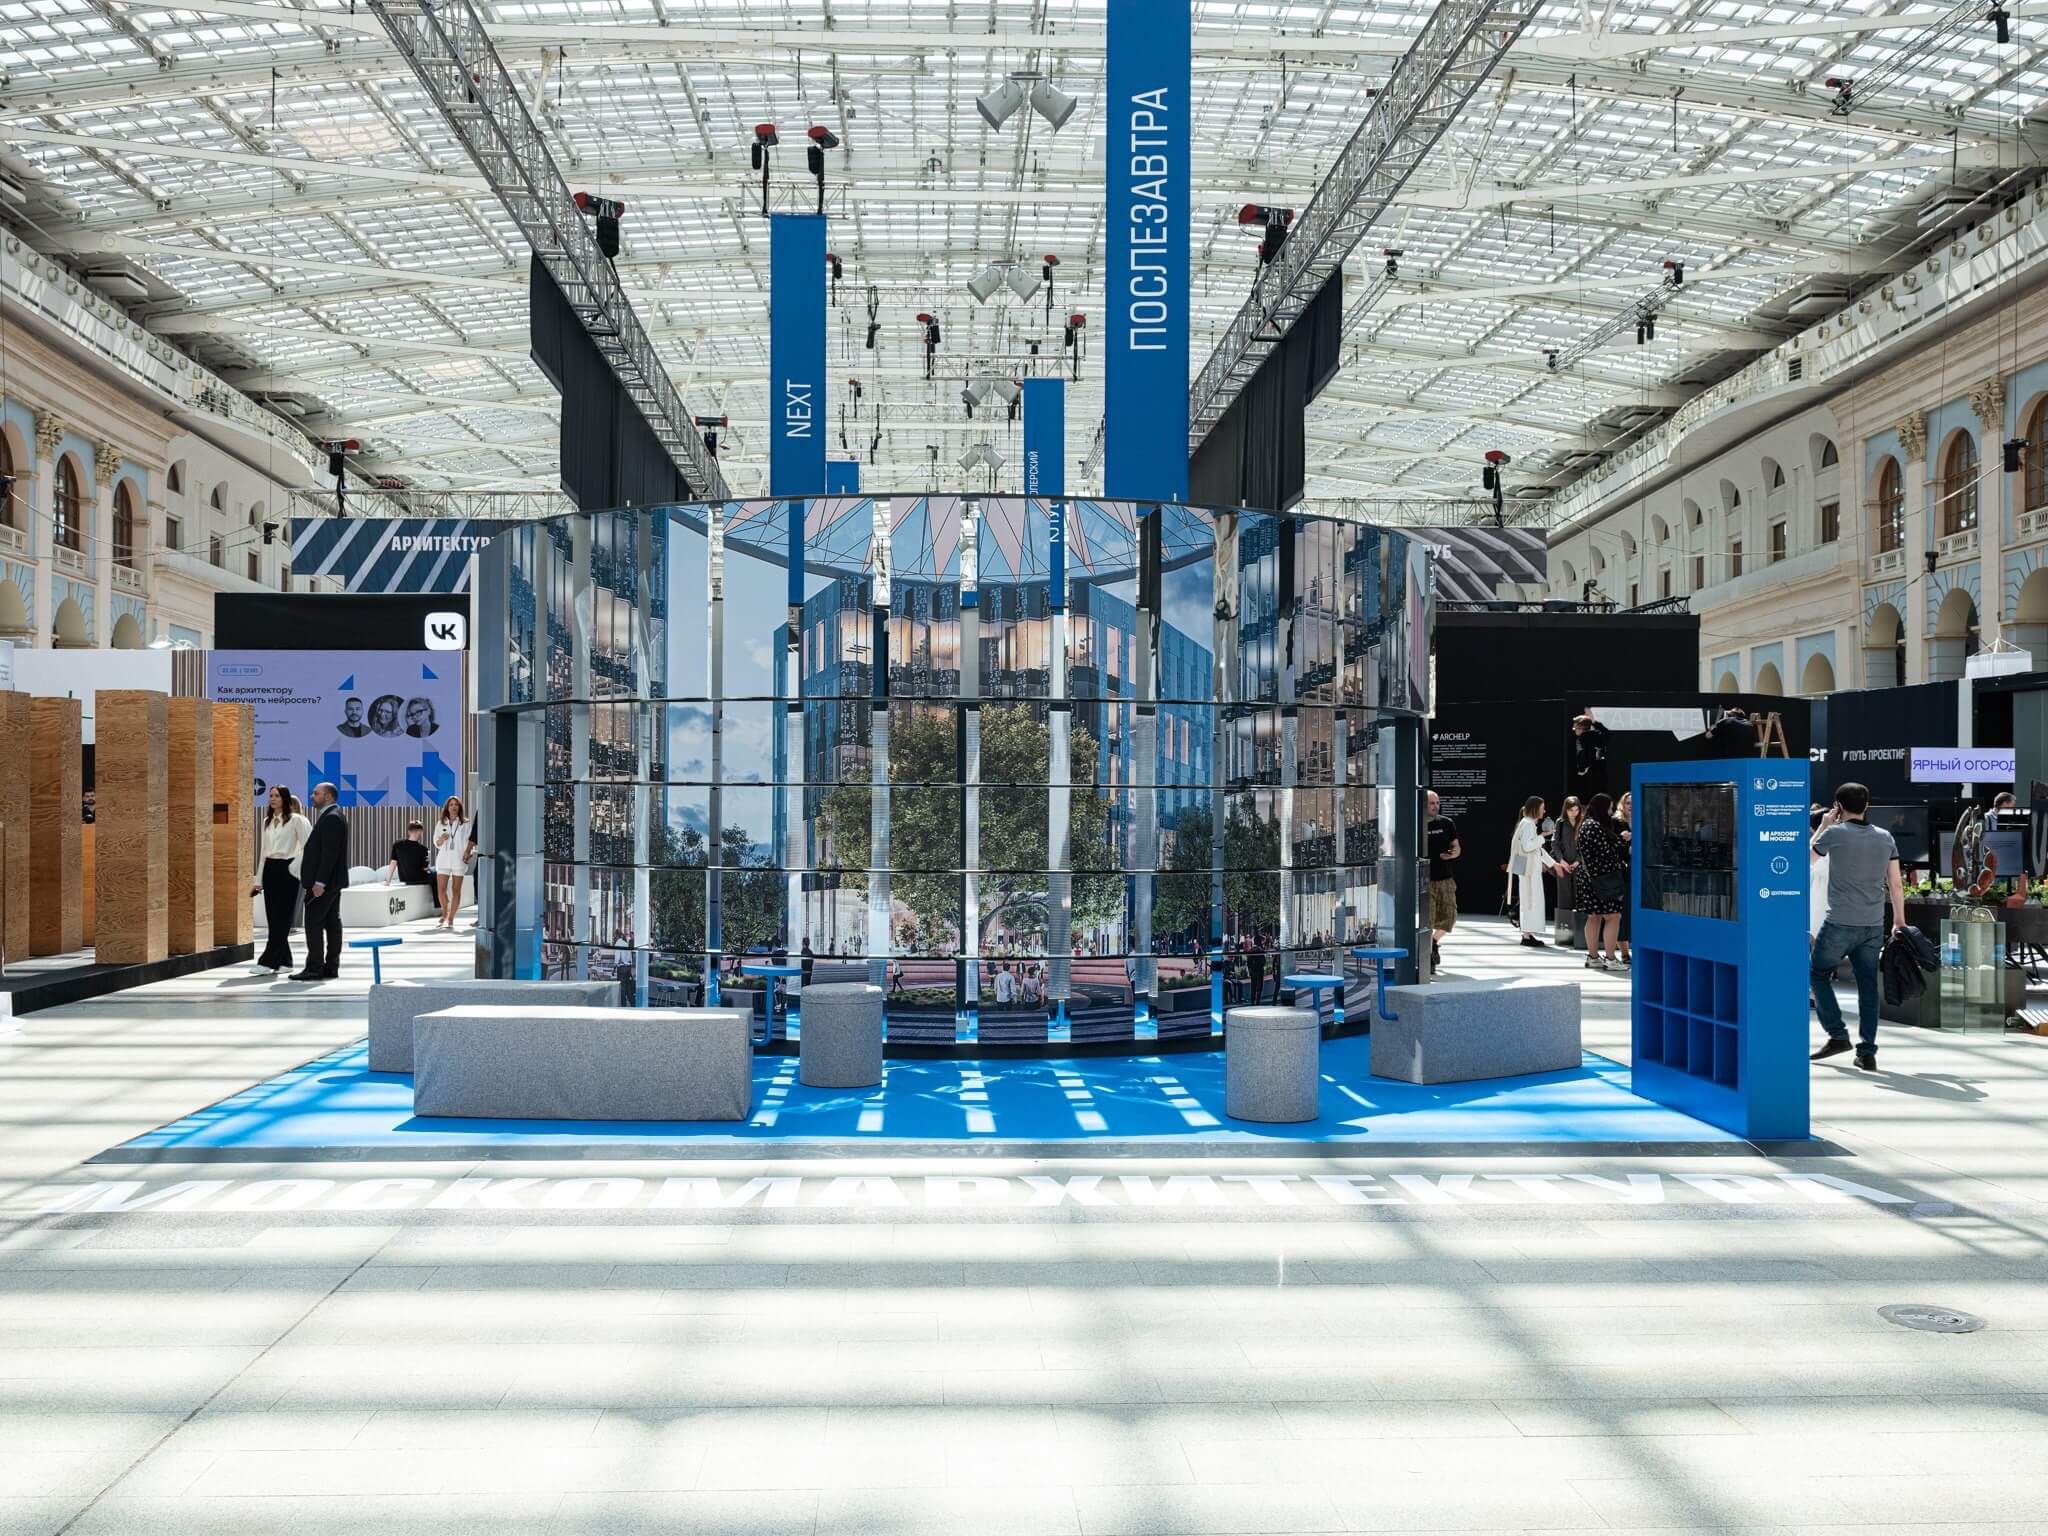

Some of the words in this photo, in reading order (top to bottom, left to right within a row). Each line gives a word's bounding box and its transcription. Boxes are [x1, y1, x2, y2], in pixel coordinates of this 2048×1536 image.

[1129, 86, 1169, 350] ПОСЛЕЗАВТРА
[786, 379, 812, 437] NEXT
[391, 535, 496, 552] АРХИТЕКТУР
[430, 623, 457, 640] VK
[217, 686, 234, 694] Как
[235, 687, 293, 695] архитектору
[268, 696, 322, 705] нейросеть?
[1439, 733, 1470, 741] ARCHELP
[42, 1173, 1917, 1213] МОСКОМАРХИТЕКТУРА
